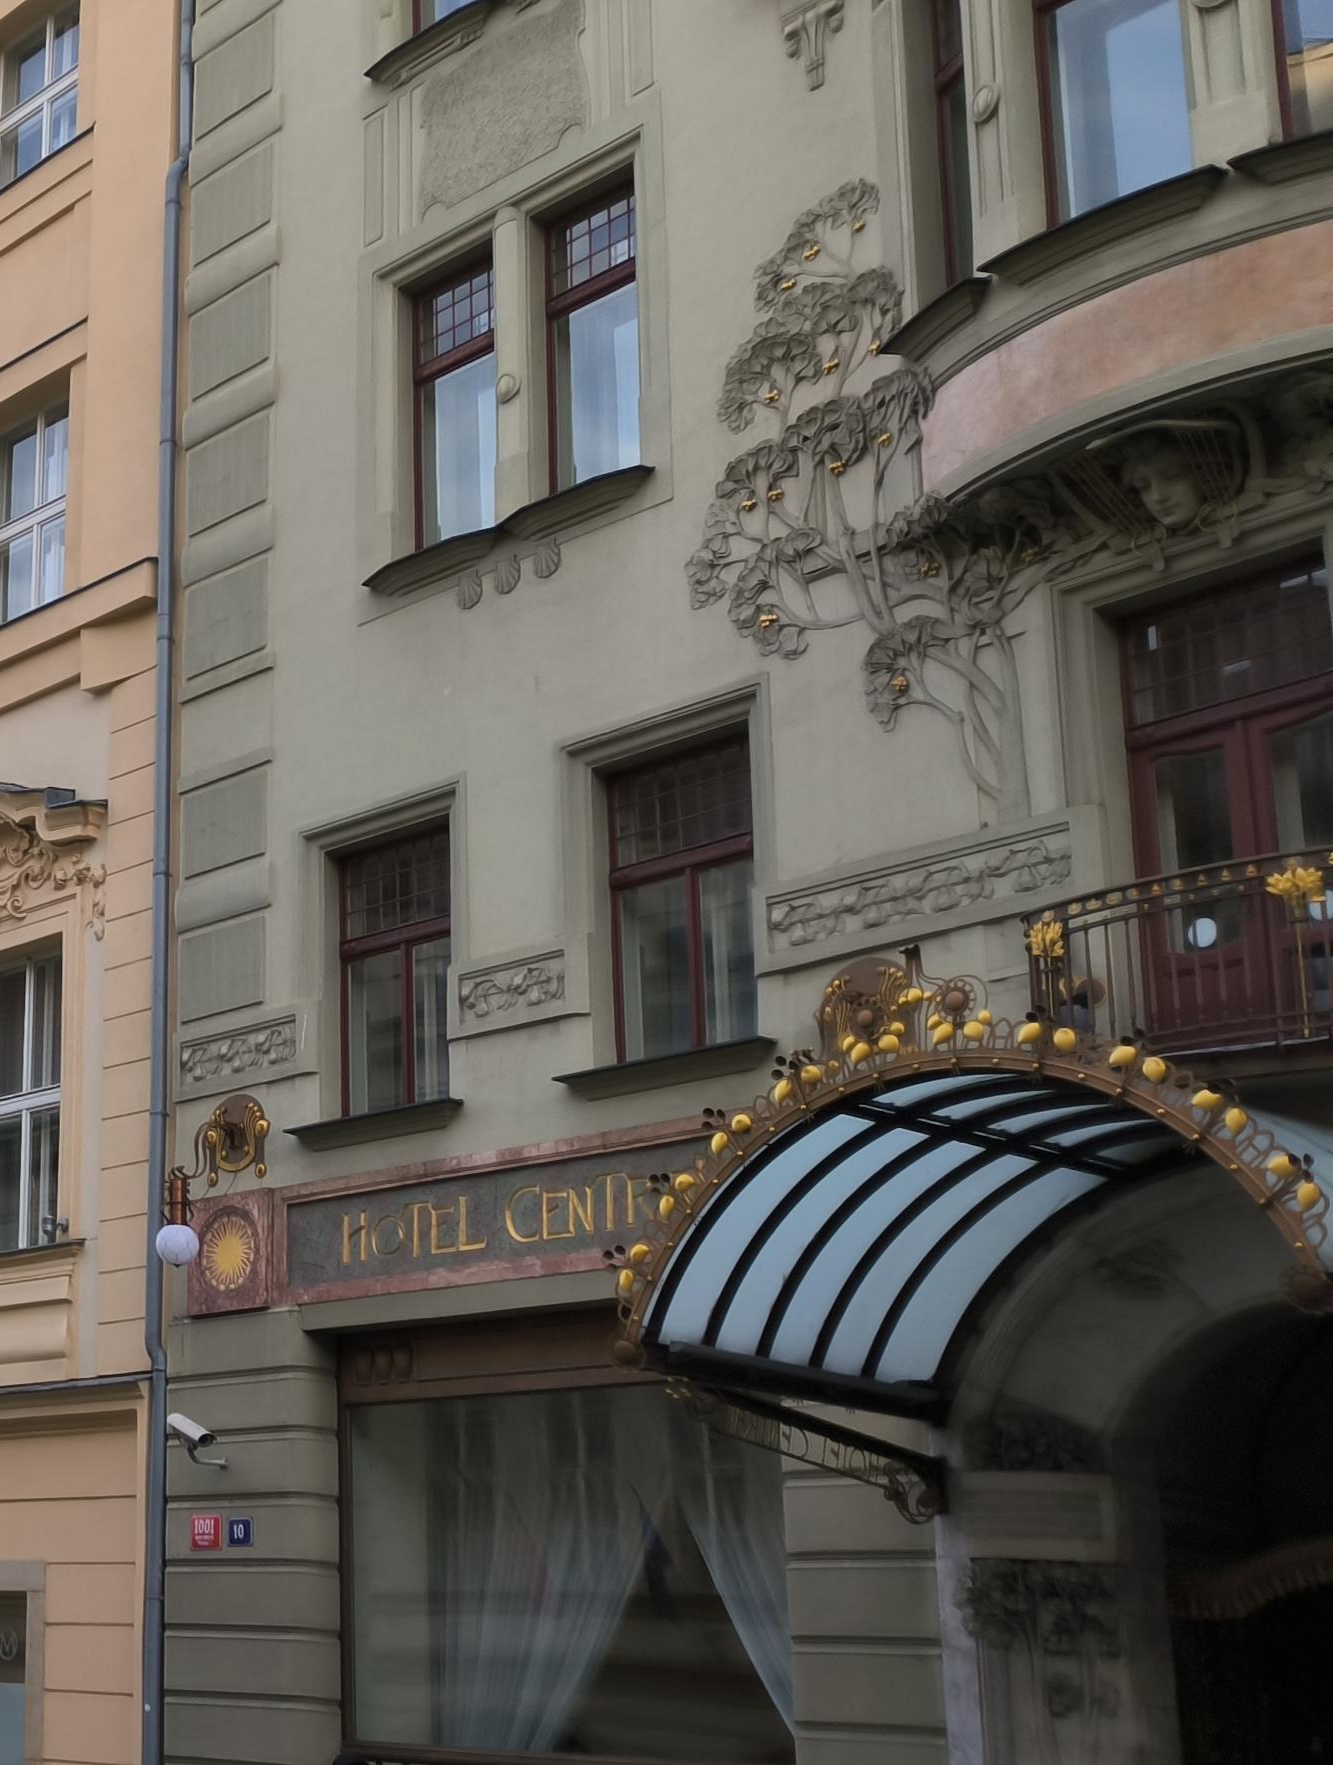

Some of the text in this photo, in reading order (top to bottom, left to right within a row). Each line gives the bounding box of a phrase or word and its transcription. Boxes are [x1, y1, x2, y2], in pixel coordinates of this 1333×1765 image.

[341, 1172, 654, 1264] HOTEL CENTR
[194, 1518, 214, 1535] 1001
[233, 1524, 244, 1540] 10
